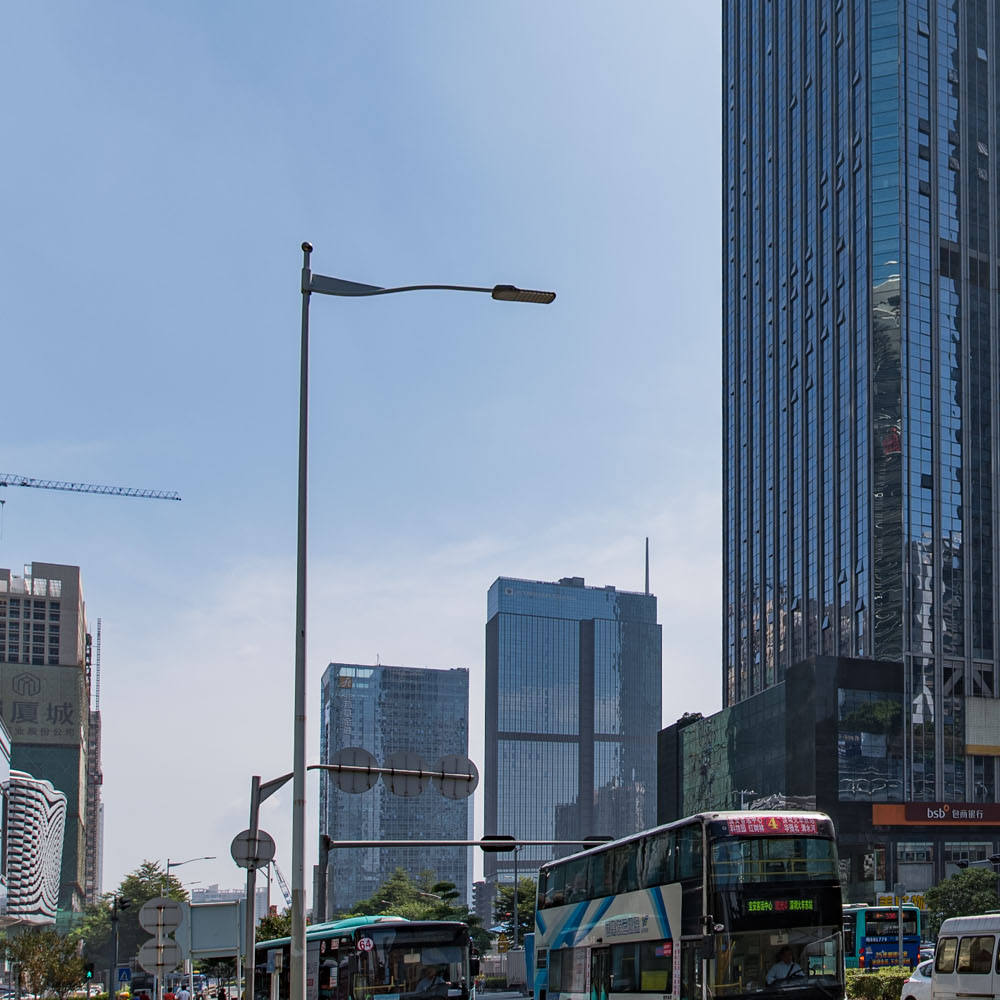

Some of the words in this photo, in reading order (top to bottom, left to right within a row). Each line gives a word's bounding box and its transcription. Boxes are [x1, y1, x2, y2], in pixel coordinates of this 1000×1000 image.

[0, 701, 75, 725] 厦城
[927, 807, 946, 819] bsb
[951, 809, 984, 820] 包商银行
[768, 817, 778, 829] 4
[359, 939, 371, 949] 64
